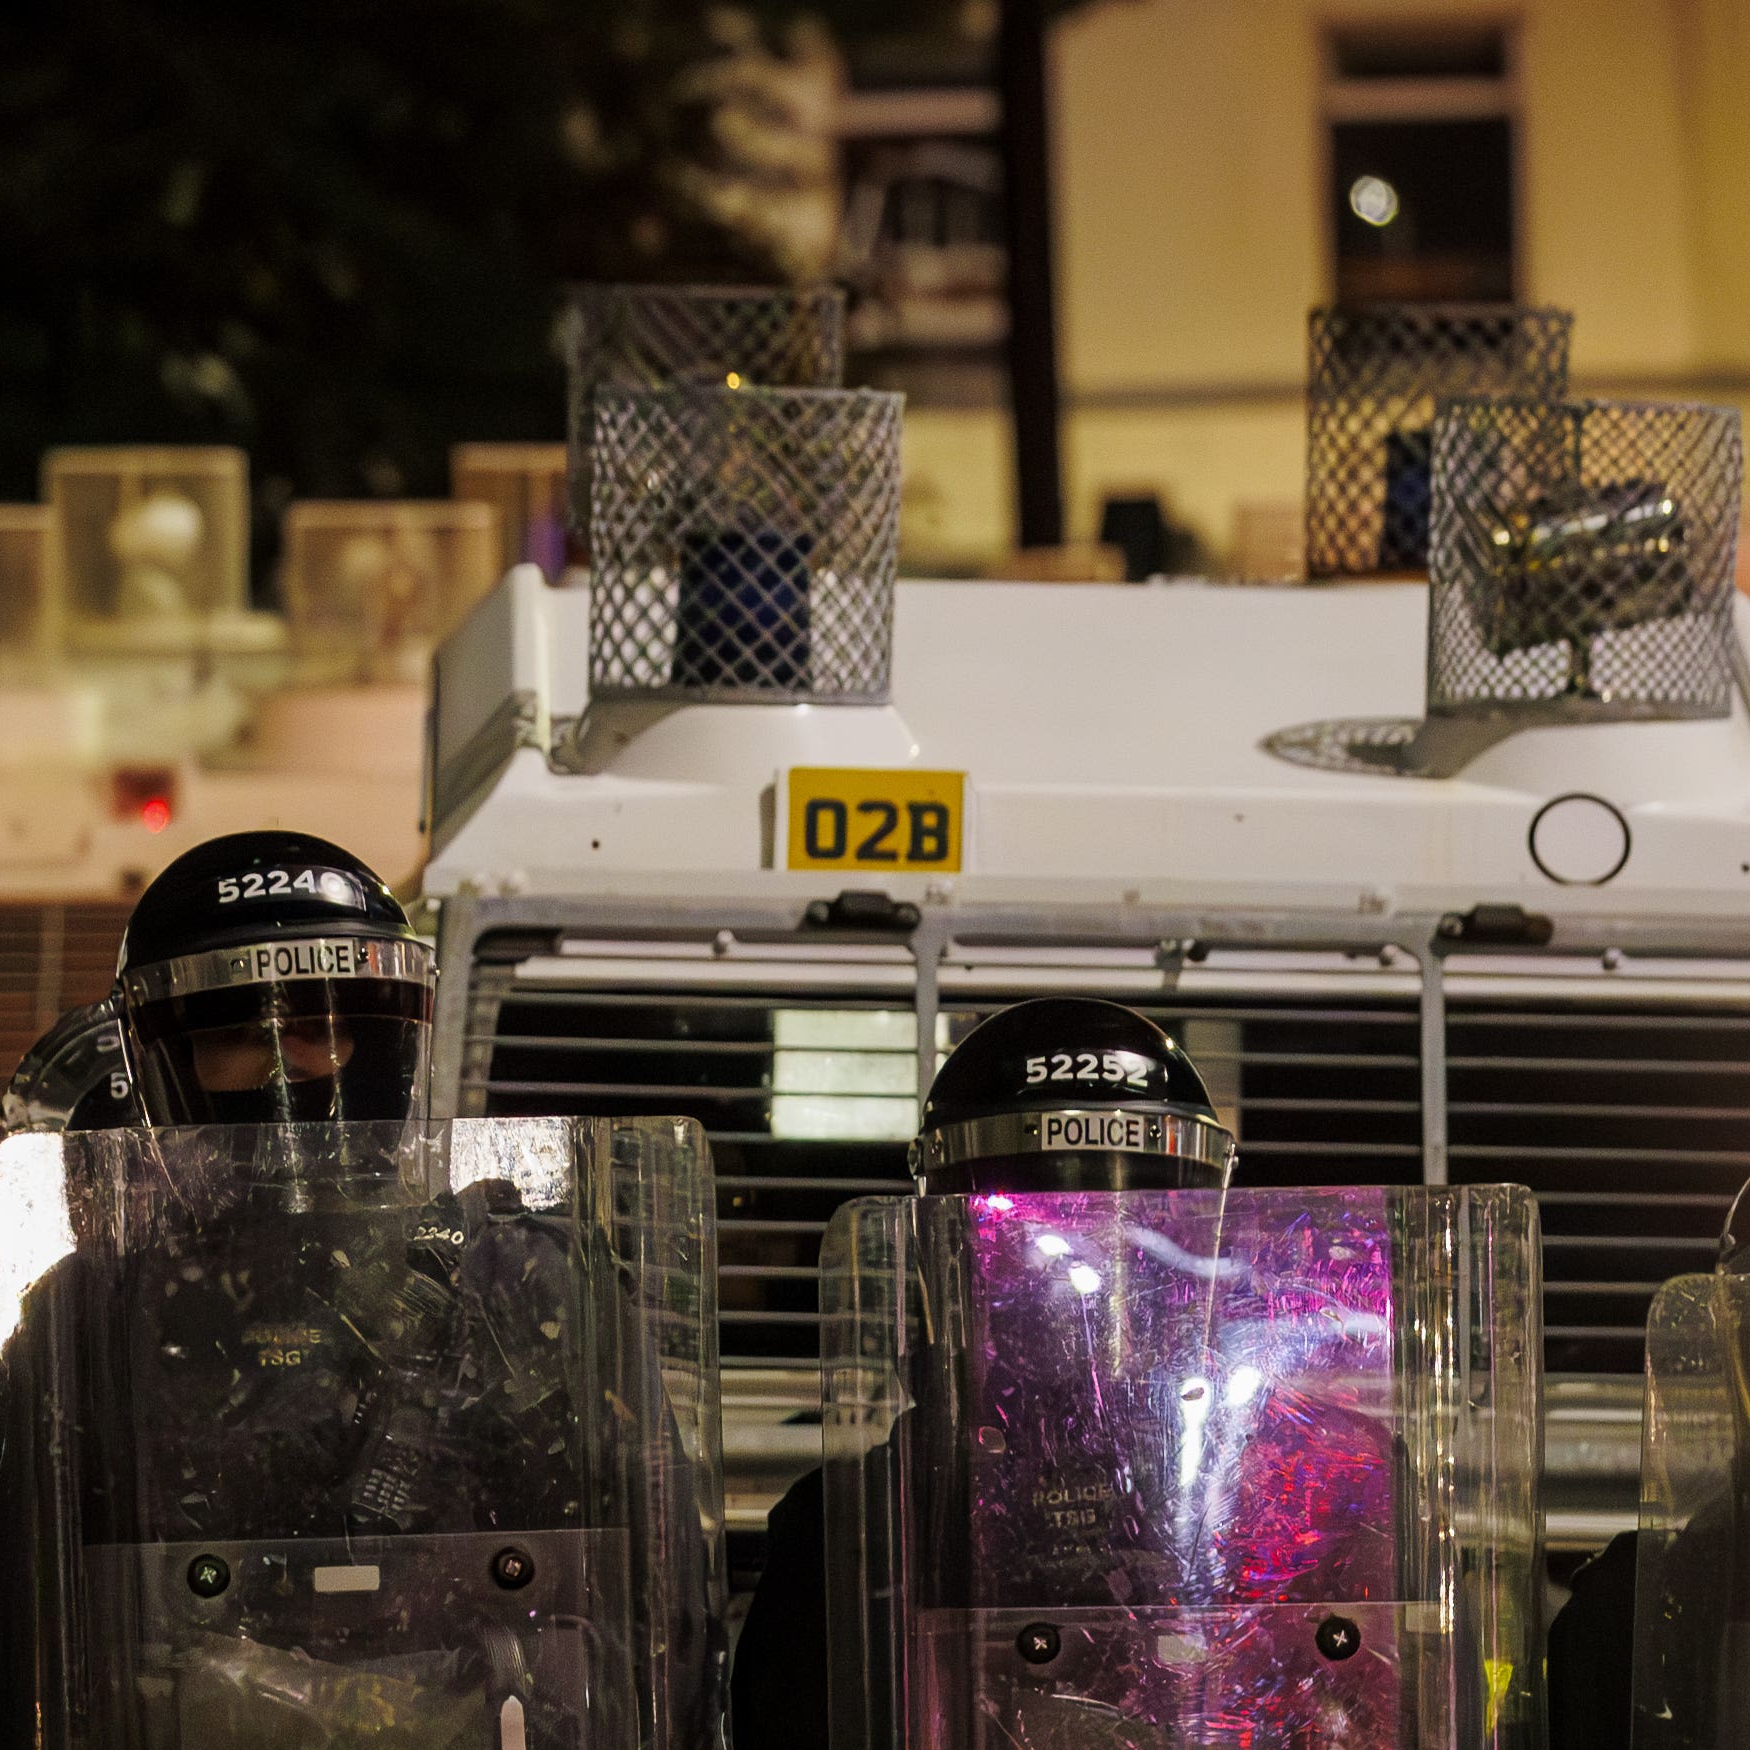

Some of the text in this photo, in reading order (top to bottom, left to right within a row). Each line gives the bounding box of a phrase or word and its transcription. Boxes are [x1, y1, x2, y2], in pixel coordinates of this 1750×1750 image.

[805, 799, 950, 861] 02B
[256, 945, 352, 978] POLICE
[1026, 1053, 1148, 1087] 52252
[1047, 1117, 1140, 1148] POLICE
